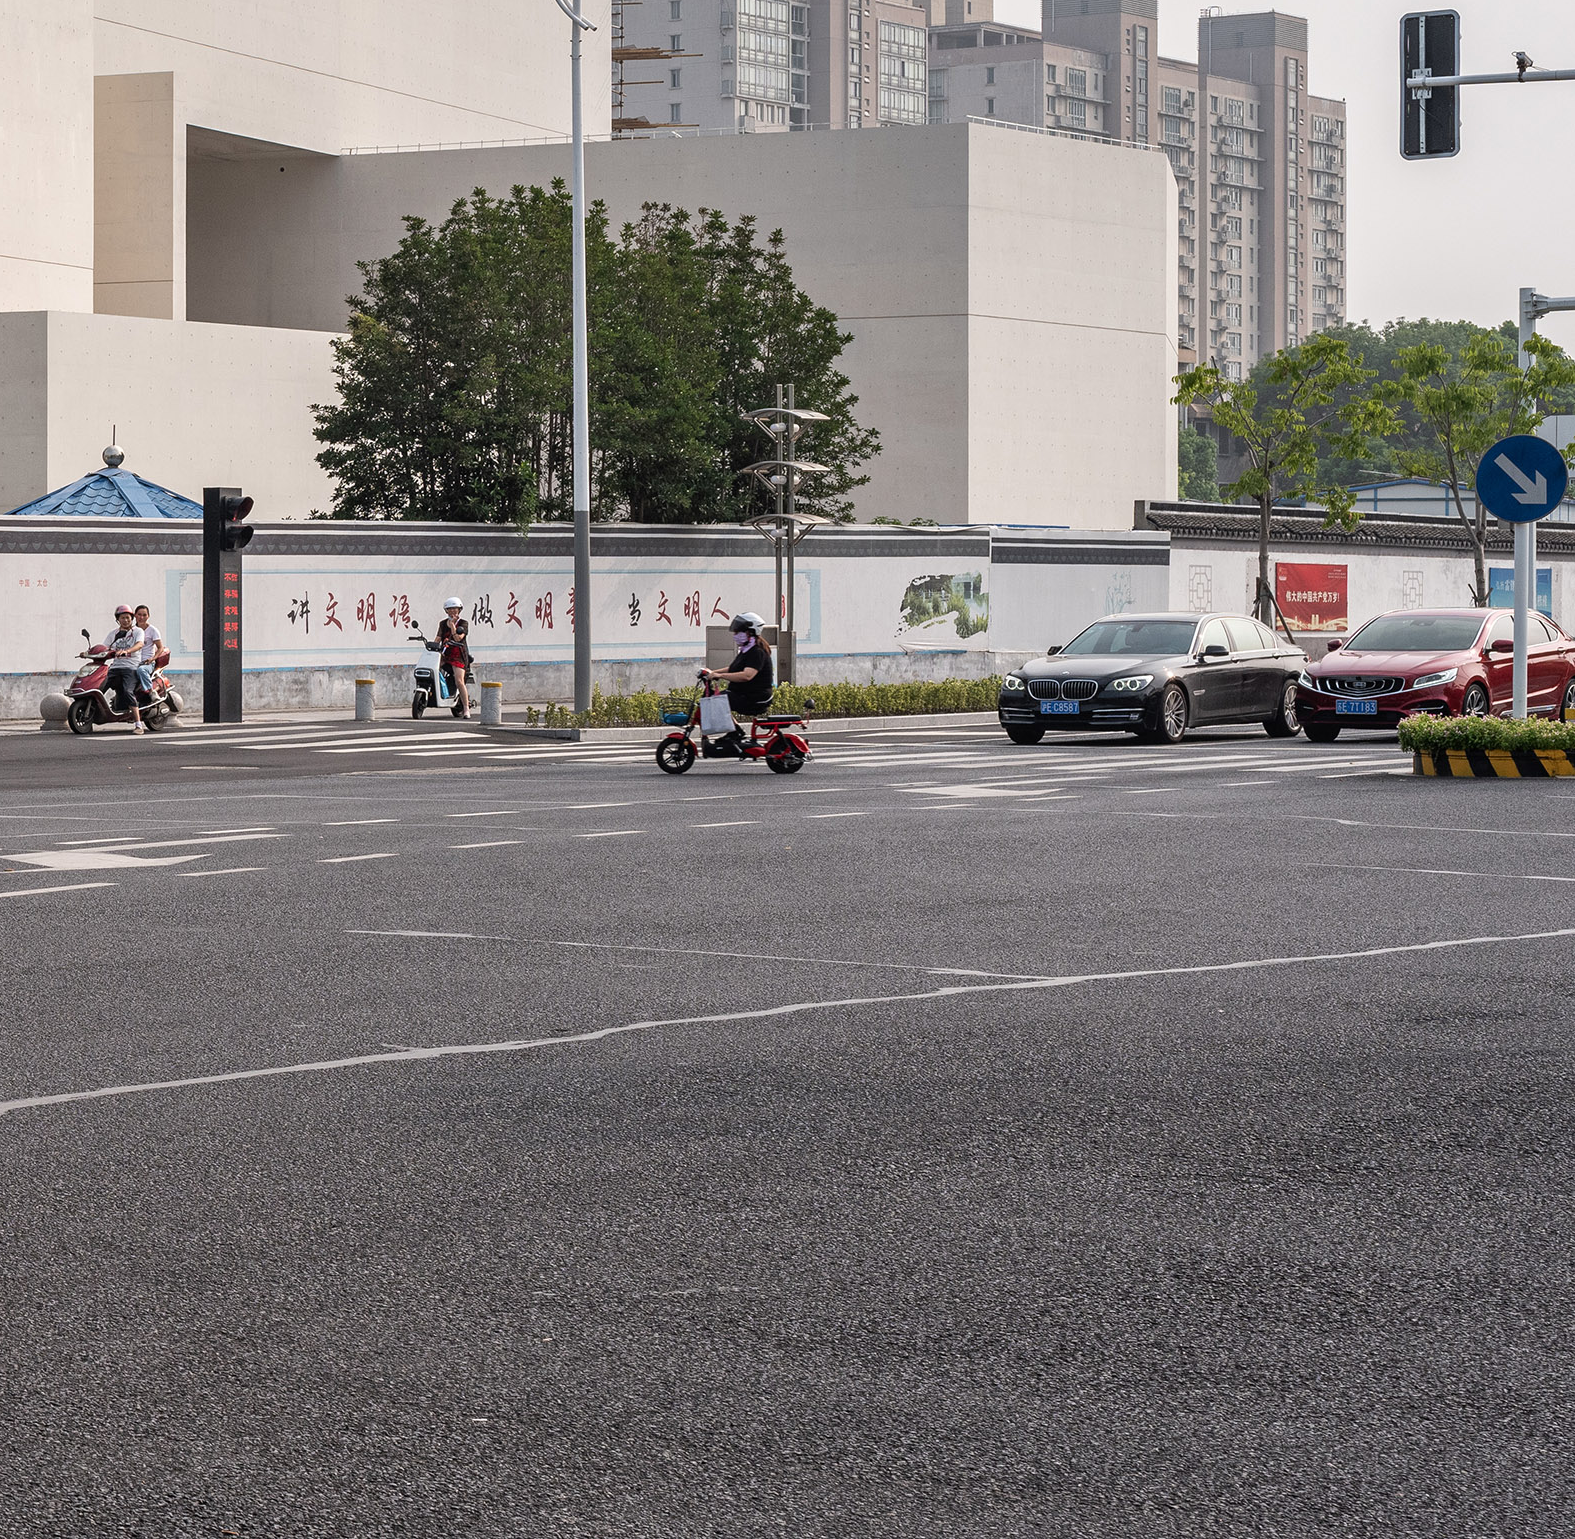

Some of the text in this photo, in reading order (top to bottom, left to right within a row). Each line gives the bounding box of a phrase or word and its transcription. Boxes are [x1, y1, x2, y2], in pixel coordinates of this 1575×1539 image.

[287, 591, 411, 634] 讲文明语
[628, 590, 730, 627] 当文明人
